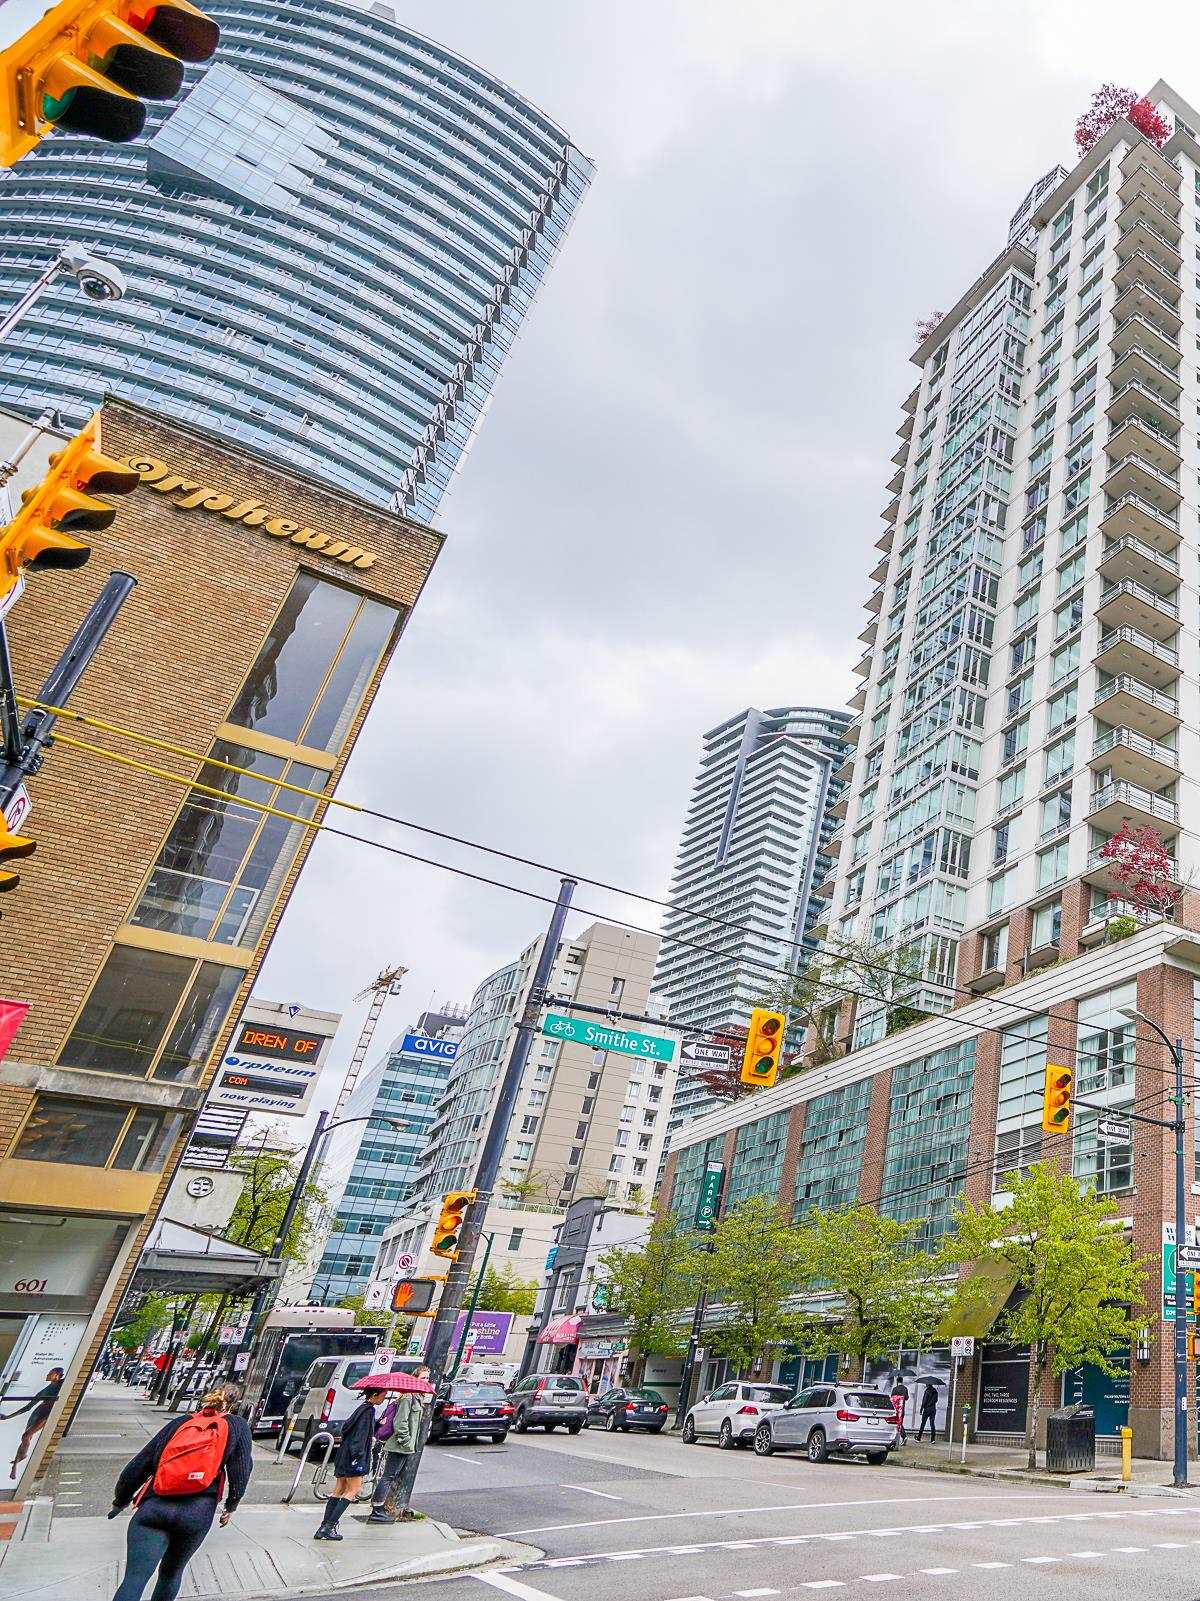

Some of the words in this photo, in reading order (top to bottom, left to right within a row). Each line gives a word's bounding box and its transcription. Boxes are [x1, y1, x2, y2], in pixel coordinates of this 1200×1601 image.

[120, 455, 379, 568] Orpheum
[241, 1030, 288, 1050] DREN
[293, 1040, 318, 1054] OF
[584, 1026, 639, 1051] Smithe
[640, 1039, 660, 1056] St.
[694, 1047, 709, 1056] ONE
[712, 1050, 727, 1058] WAY
[225, 1056, 317, 1078] Orpheum
[219, 1091, 248, 1101] now
[249, 1094, 297, 1108] playing
[706, 1175, 716, 1204] PARK
[14, 1278, 48, 1293] 601
